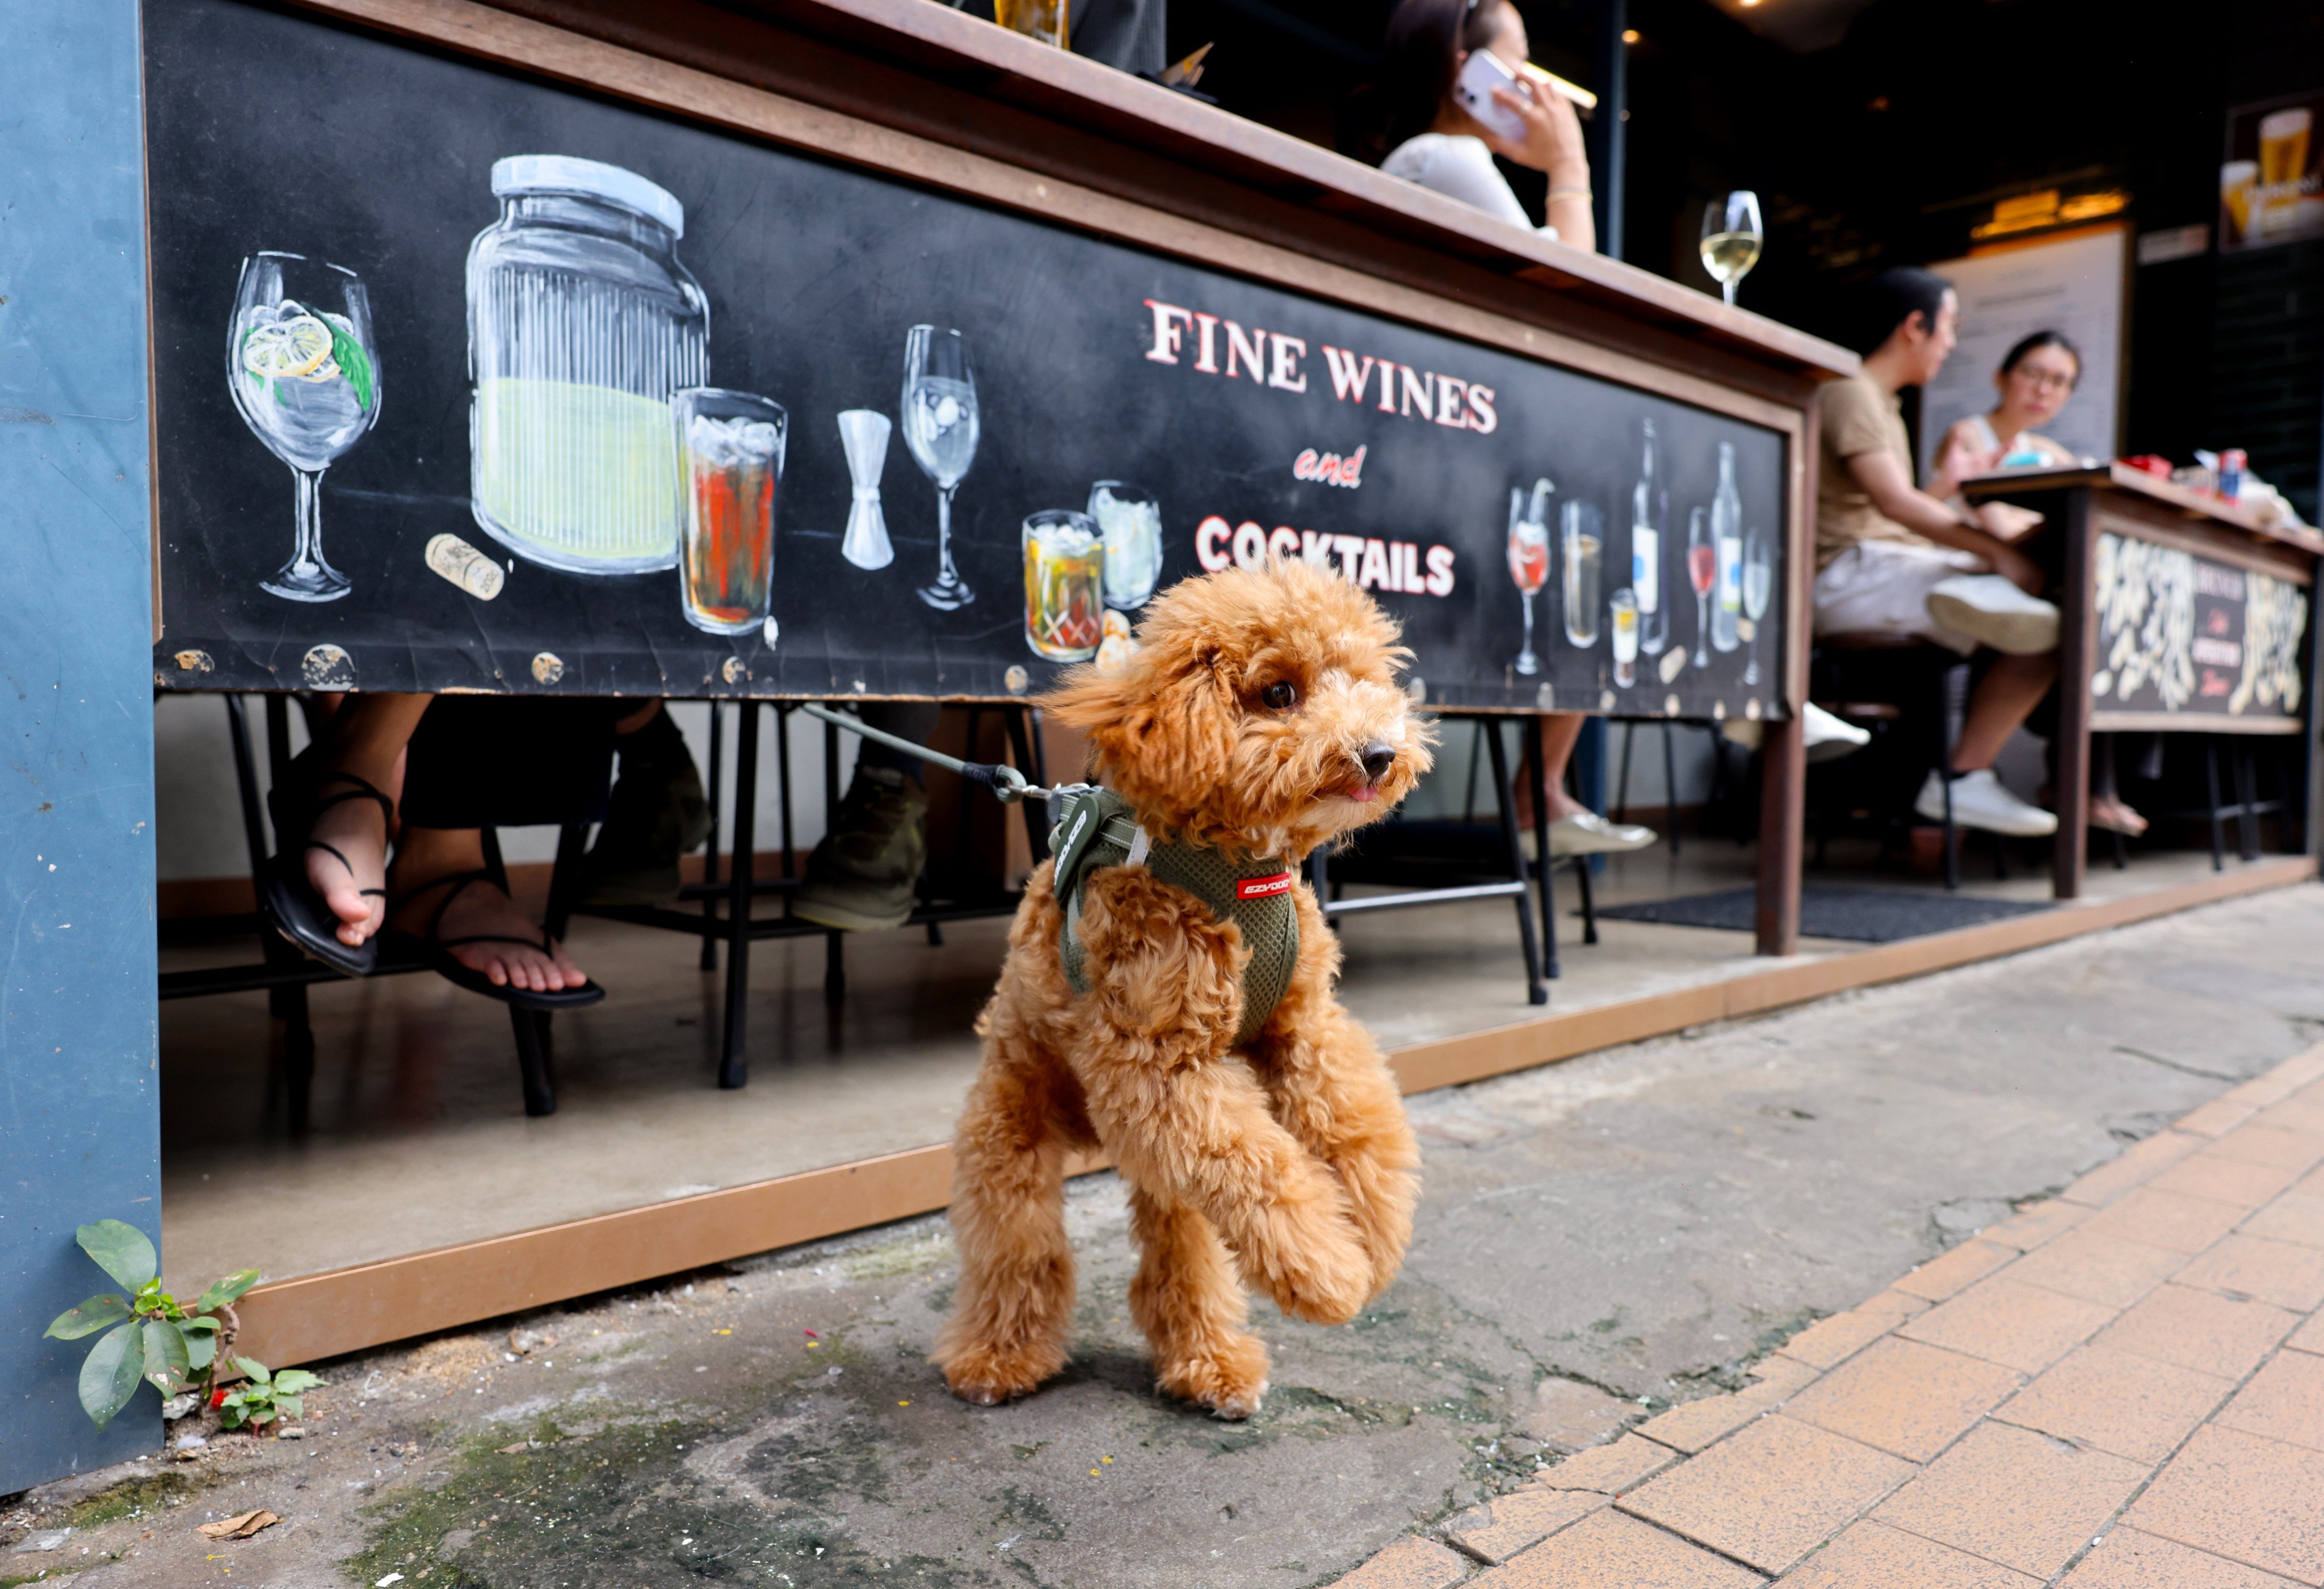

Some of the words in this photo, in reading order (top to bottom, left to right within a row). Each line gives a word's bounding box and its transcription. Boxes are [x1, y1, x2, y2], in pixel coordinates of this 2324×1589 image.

[1143, 298, 1306, 393] FINE
[1321, 344, 1497, 434] WINES
[1293, 443, 1368, 489] and
[1195, 515, 1455, 597] COCKTAILS
